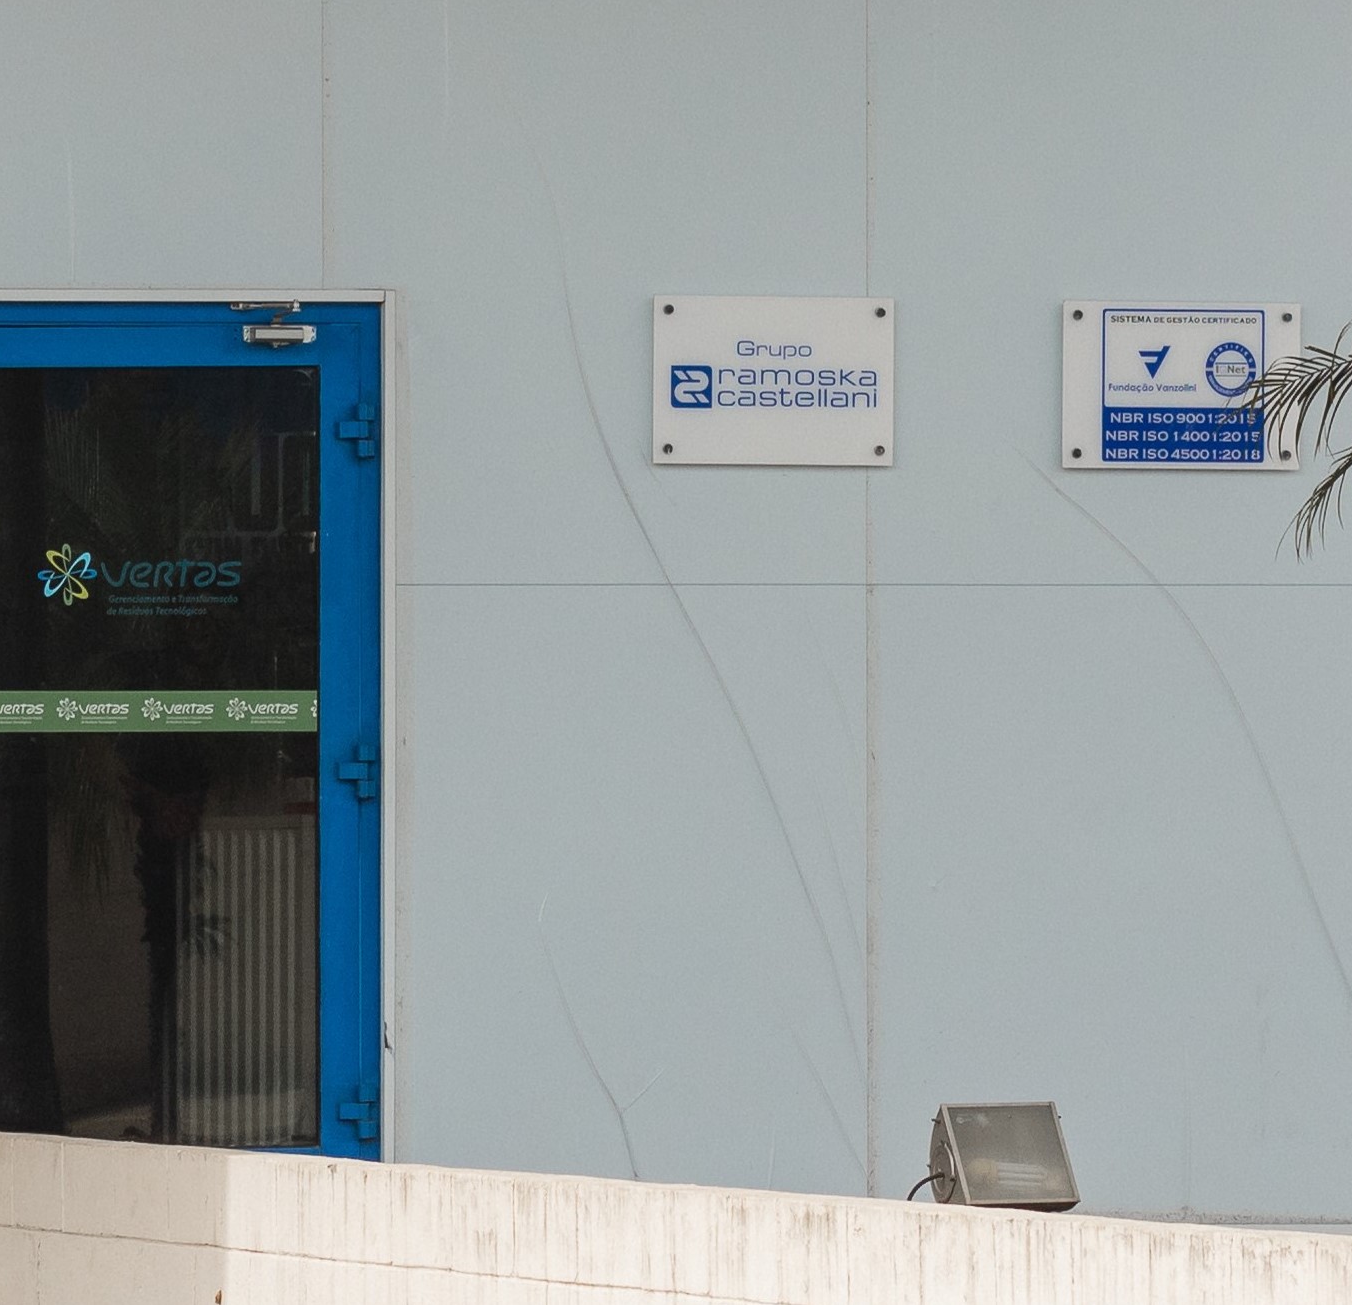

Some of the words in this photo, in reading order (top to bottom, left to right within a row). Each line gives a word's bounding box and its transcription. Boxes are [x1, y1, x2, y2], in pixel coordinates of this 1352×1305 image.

[1110, 315, 1152, 324] SISTEMA
[1153, 316, 1165, 324] DE
[1166, 315, 1200, 325] GESTÃO
[1201, 316, 1257, 325] CERTIFICADO
[736, 340, 813, 360] Grupo
[718, 368, 878, 387] ramoska
[1108, 382, 1154, 393] Fundação
[1155, 383, 1197, 393] Vanzolini
[717, 387, 877, 408] castellani
[1110, 412, 1144, 424] NBR
[1147, 412, 1174, 424] ISO
[1175, 412, 1257, 425] 9001:2015
[1105, 430, 1139, 442] NBR
[1142, 430, 1169, 442] ISO
[1173, 430, 1261, 443] 14001:2015
[1105, 448, 1139, 460] NBR
[1142, 448, 1169, 460] ISO
[1170, 448, 1261, 461] 45001:2018
